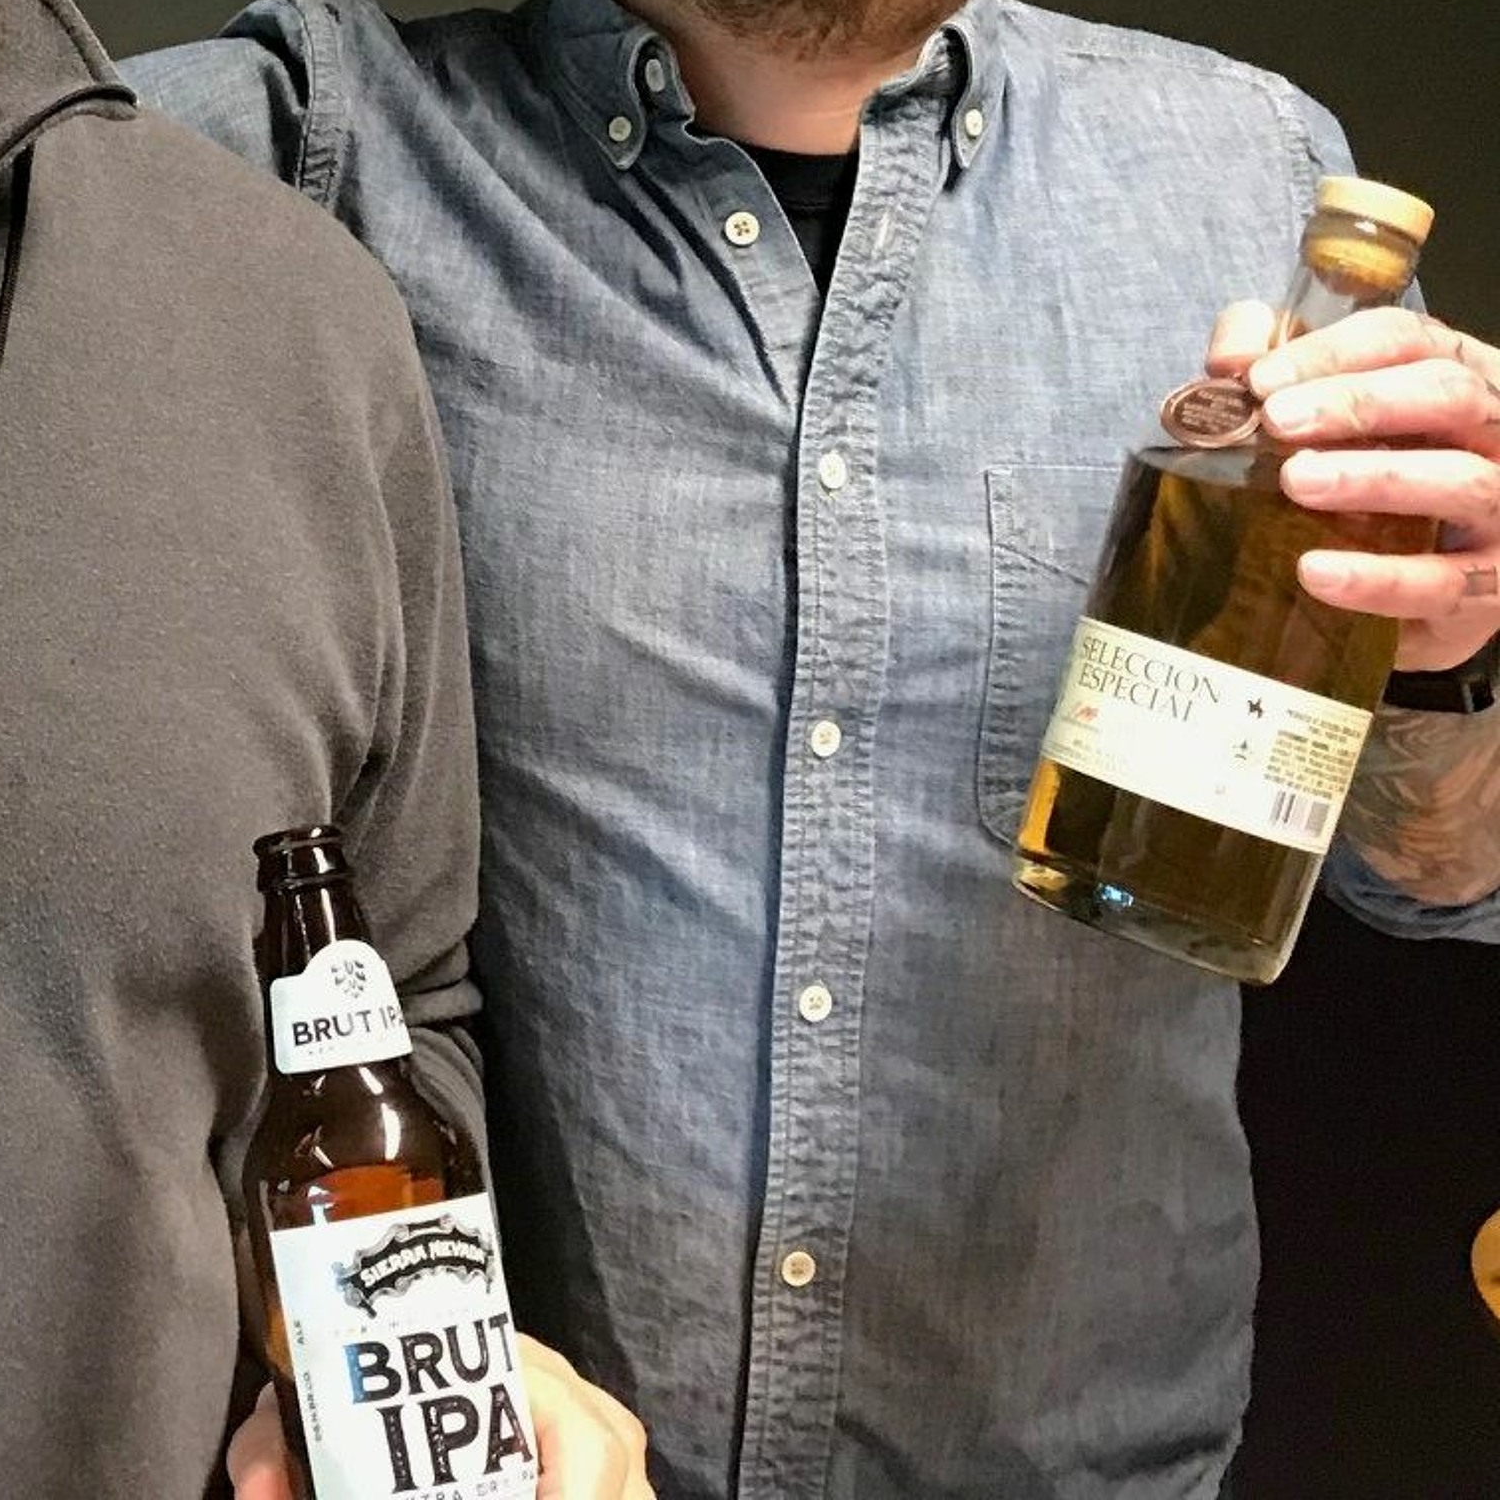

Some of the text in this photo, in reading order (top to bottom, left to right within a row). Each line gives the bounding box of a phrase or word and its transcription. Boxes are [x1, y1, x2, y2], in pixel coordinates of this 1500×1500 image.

[1081, 636, 1221, 704] SELECCION
[292, 1009, 371, 1046] BRUT
[344, 1312, 514, 1405] BRUT
[377, 1383, 534, 1494] IPA
